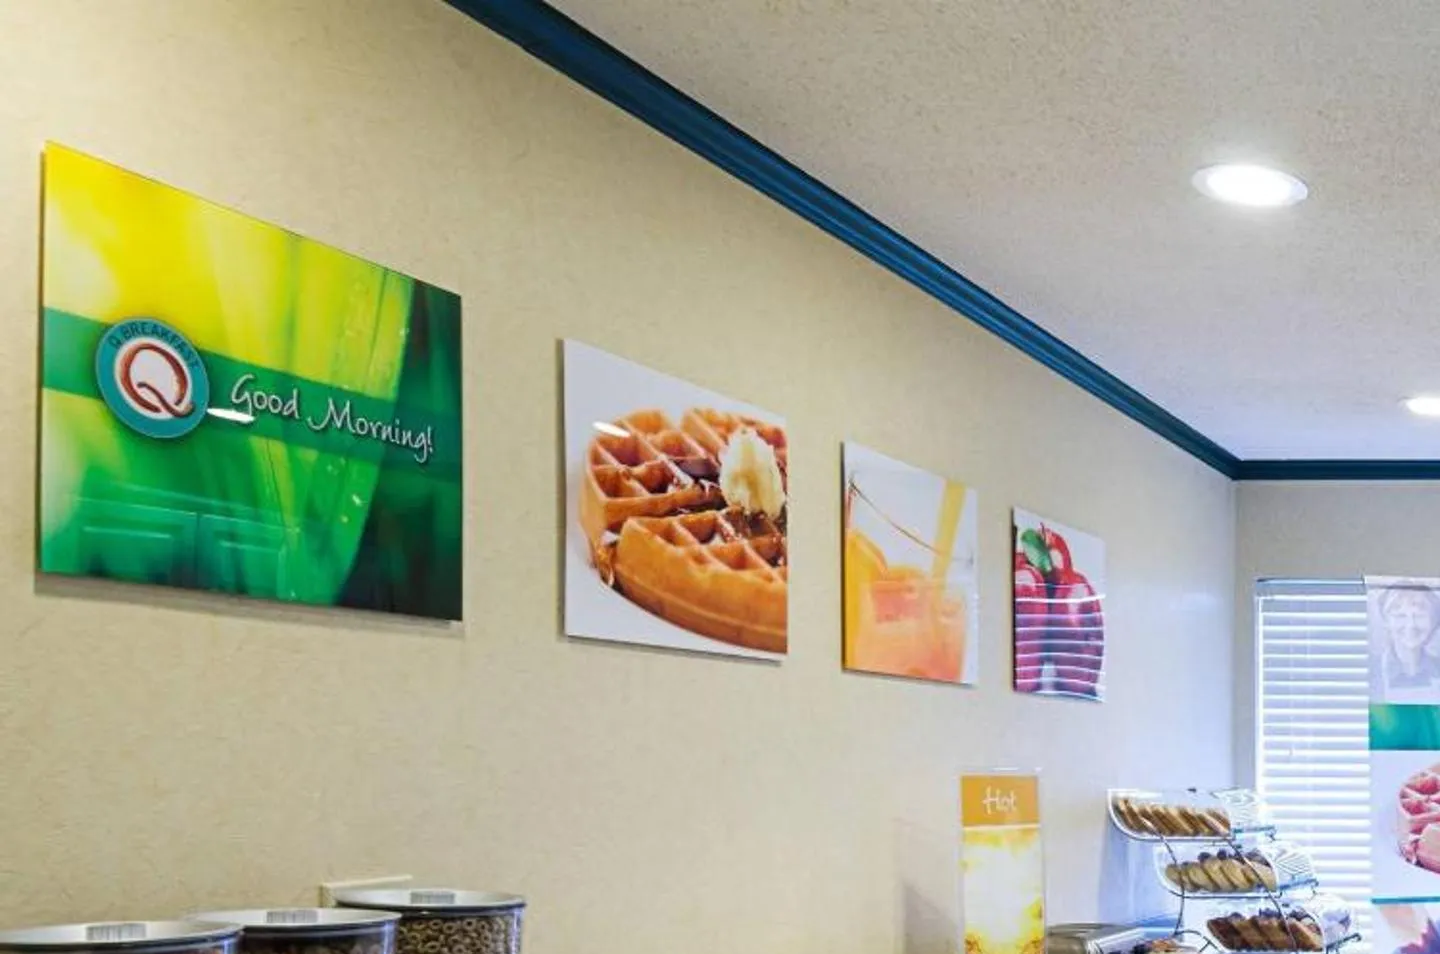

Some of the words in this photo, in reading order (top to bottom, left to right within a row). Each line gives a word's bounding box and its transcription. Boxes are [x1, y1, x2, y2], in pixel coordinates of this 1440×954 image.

[122, 320, 203, 370] BREAKFAST
[120, 342, 196, 418] Q
[231, 374, 300, 420] Good
[307, 397, 433, 464] Morning!
[982, 785, 1018, 817] Hot
